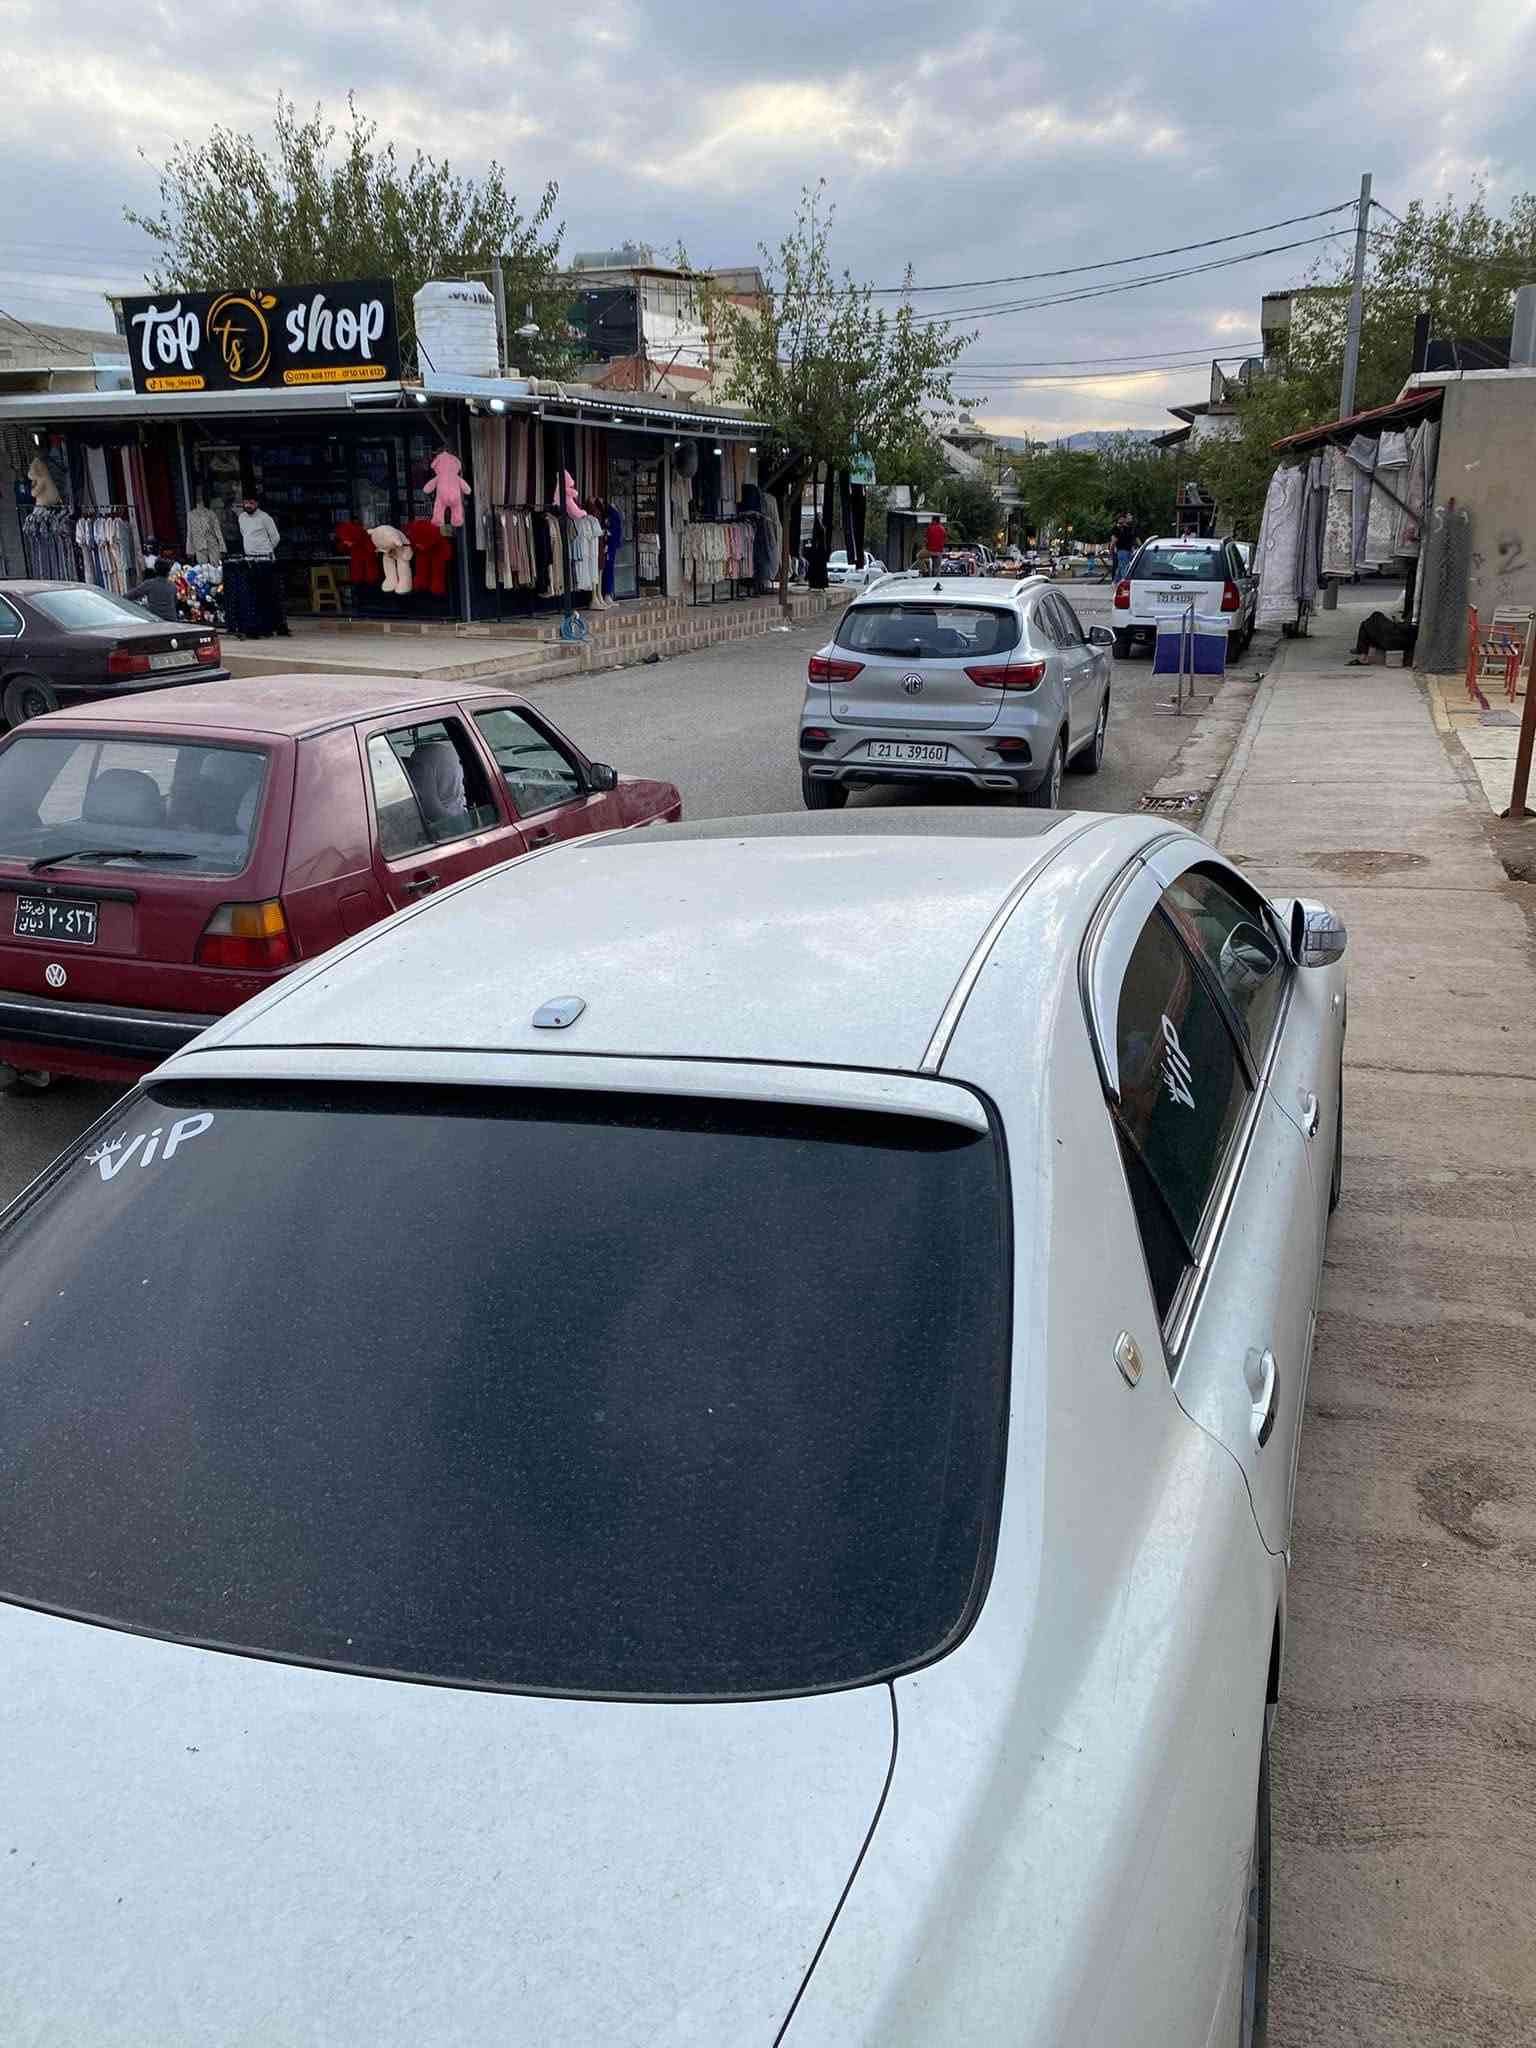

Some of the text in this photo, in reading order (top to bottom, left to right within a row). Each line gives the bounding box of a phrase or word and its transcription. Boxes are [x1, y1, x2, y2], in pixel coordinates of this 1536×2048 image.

[131, 293, 385, 370] Top shop
[878, 744, 943, 760] 21 L 39160
